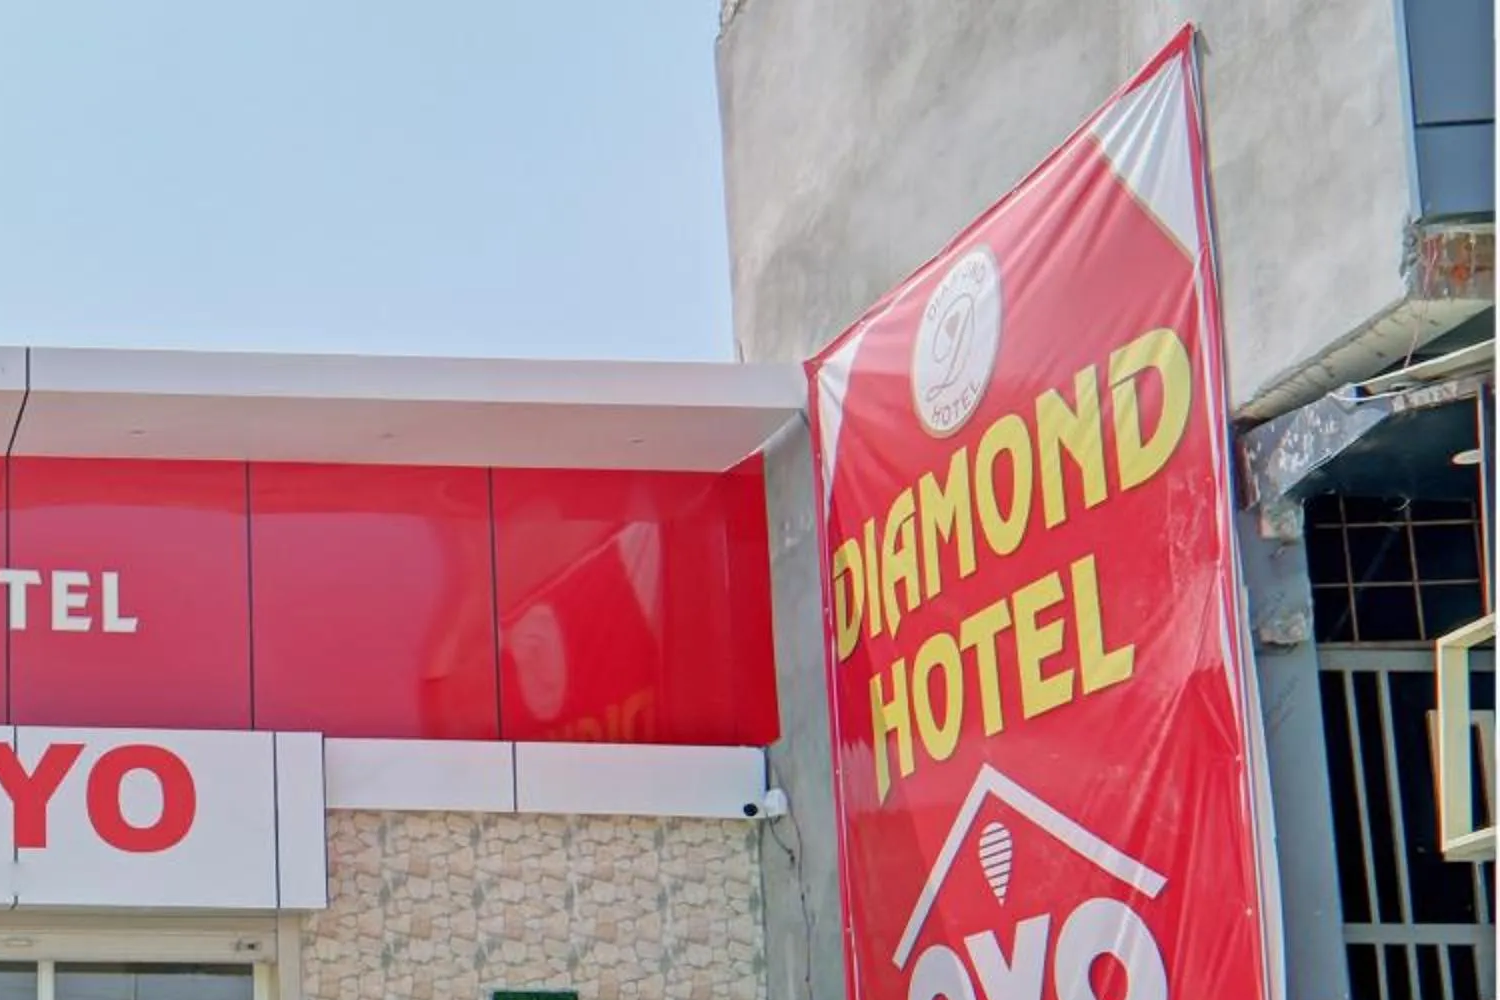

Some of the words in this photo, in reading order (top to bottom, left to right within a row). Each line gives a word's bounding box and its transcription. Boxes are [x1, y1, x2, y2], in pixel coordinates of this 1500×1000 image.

[833, 327, 1192, 662] DIAMOND
[931, 378, 981, 426] HOTEL
[868, 554, 1135, 802] HOTEL
